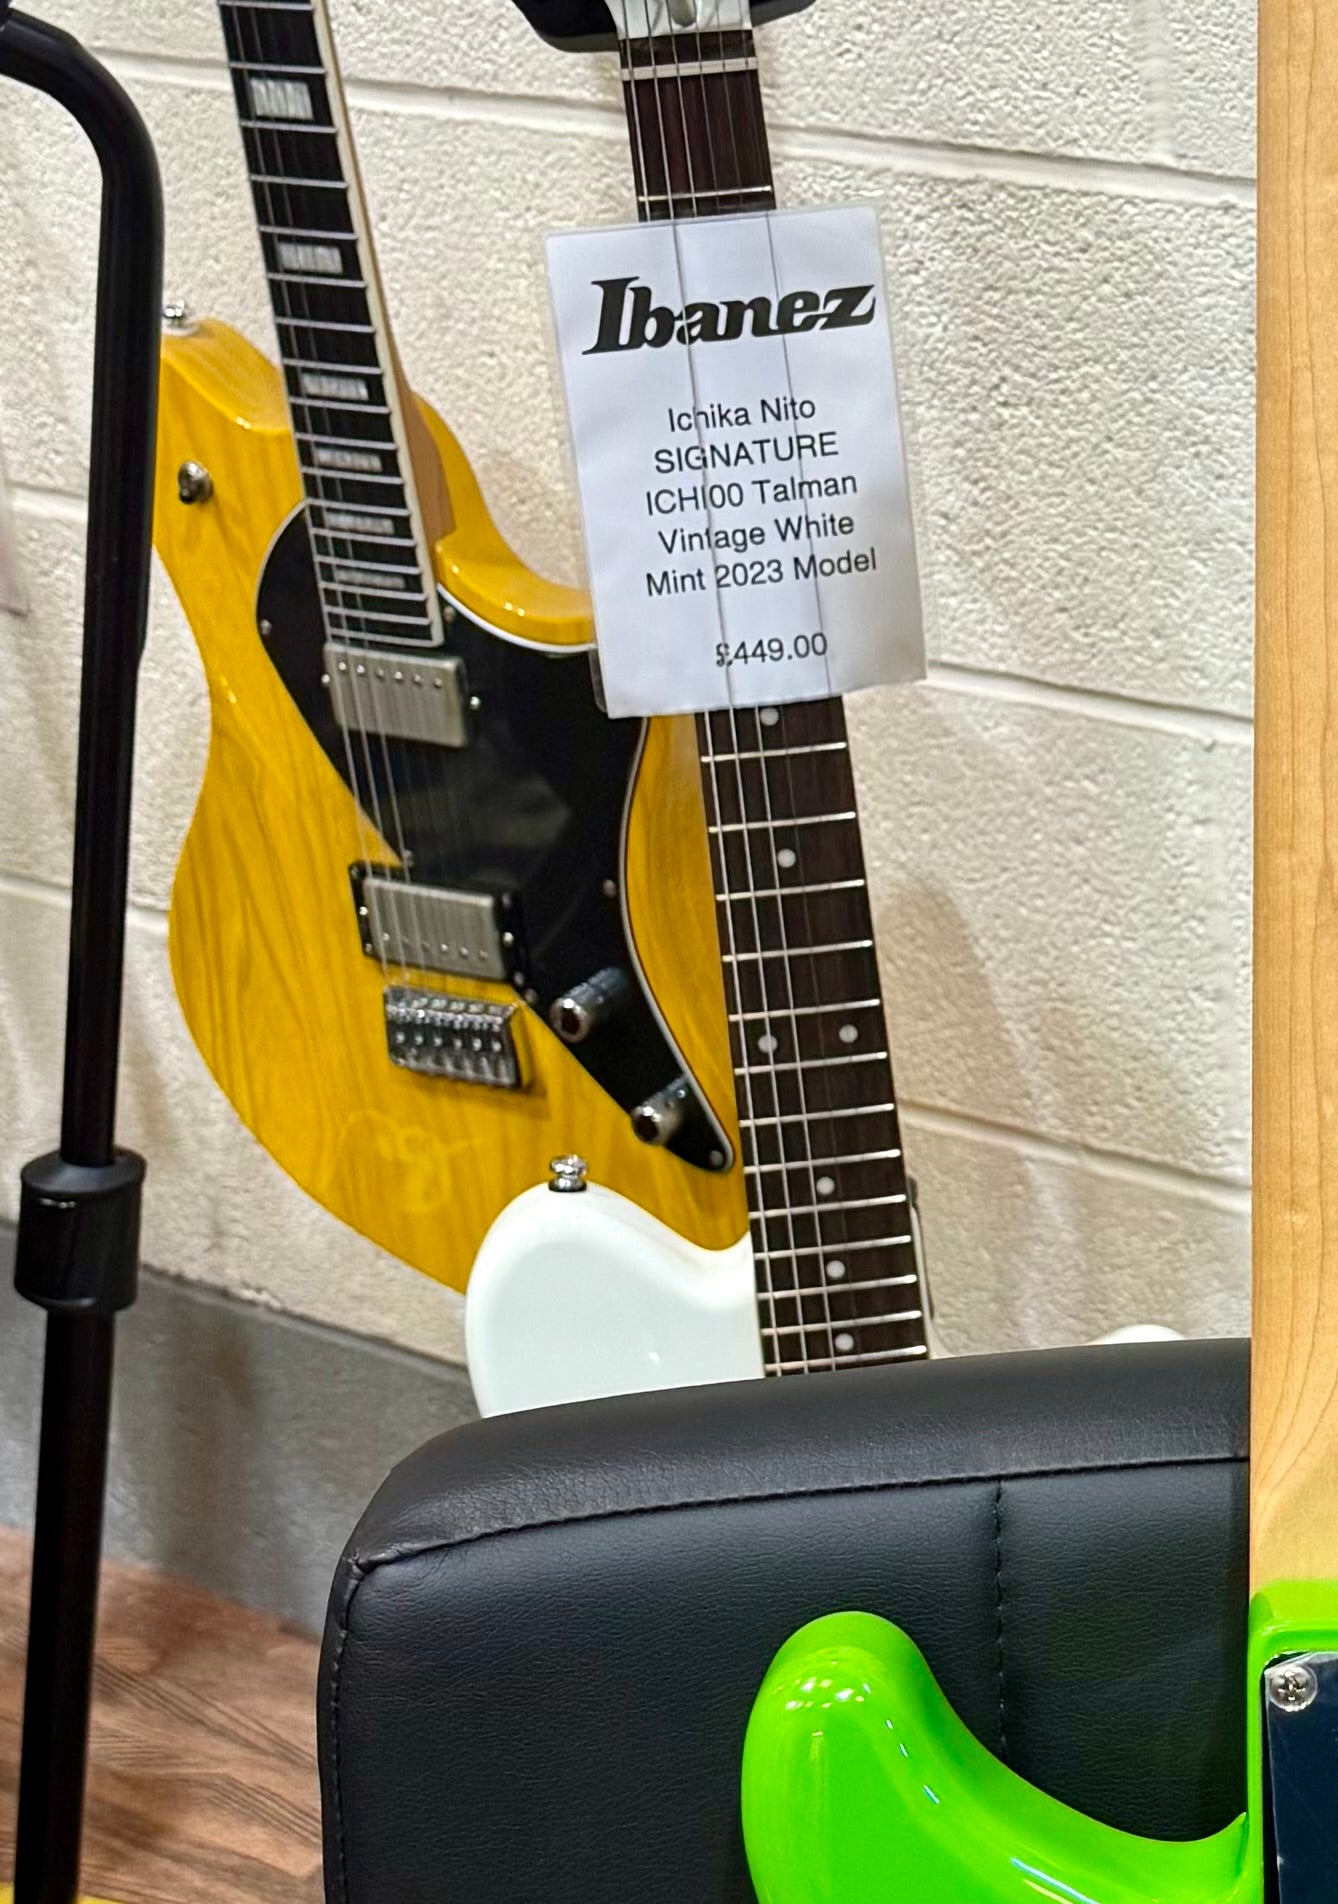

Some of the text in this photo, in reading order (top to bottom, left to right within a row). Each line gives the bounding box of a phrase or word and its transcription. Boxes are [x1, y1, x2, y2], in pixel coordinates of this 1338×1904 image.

[582, 276, 876, 356] Ibanez
[668, 396, 816, 432] Ichika Nito
[654, 431, 840, 474] SIGNATURE
[751, 475, 857, 505] Talman
[658, 513, 854, 554] Vintage White
[646, 547, 877, 597] Mint 2023 Model
